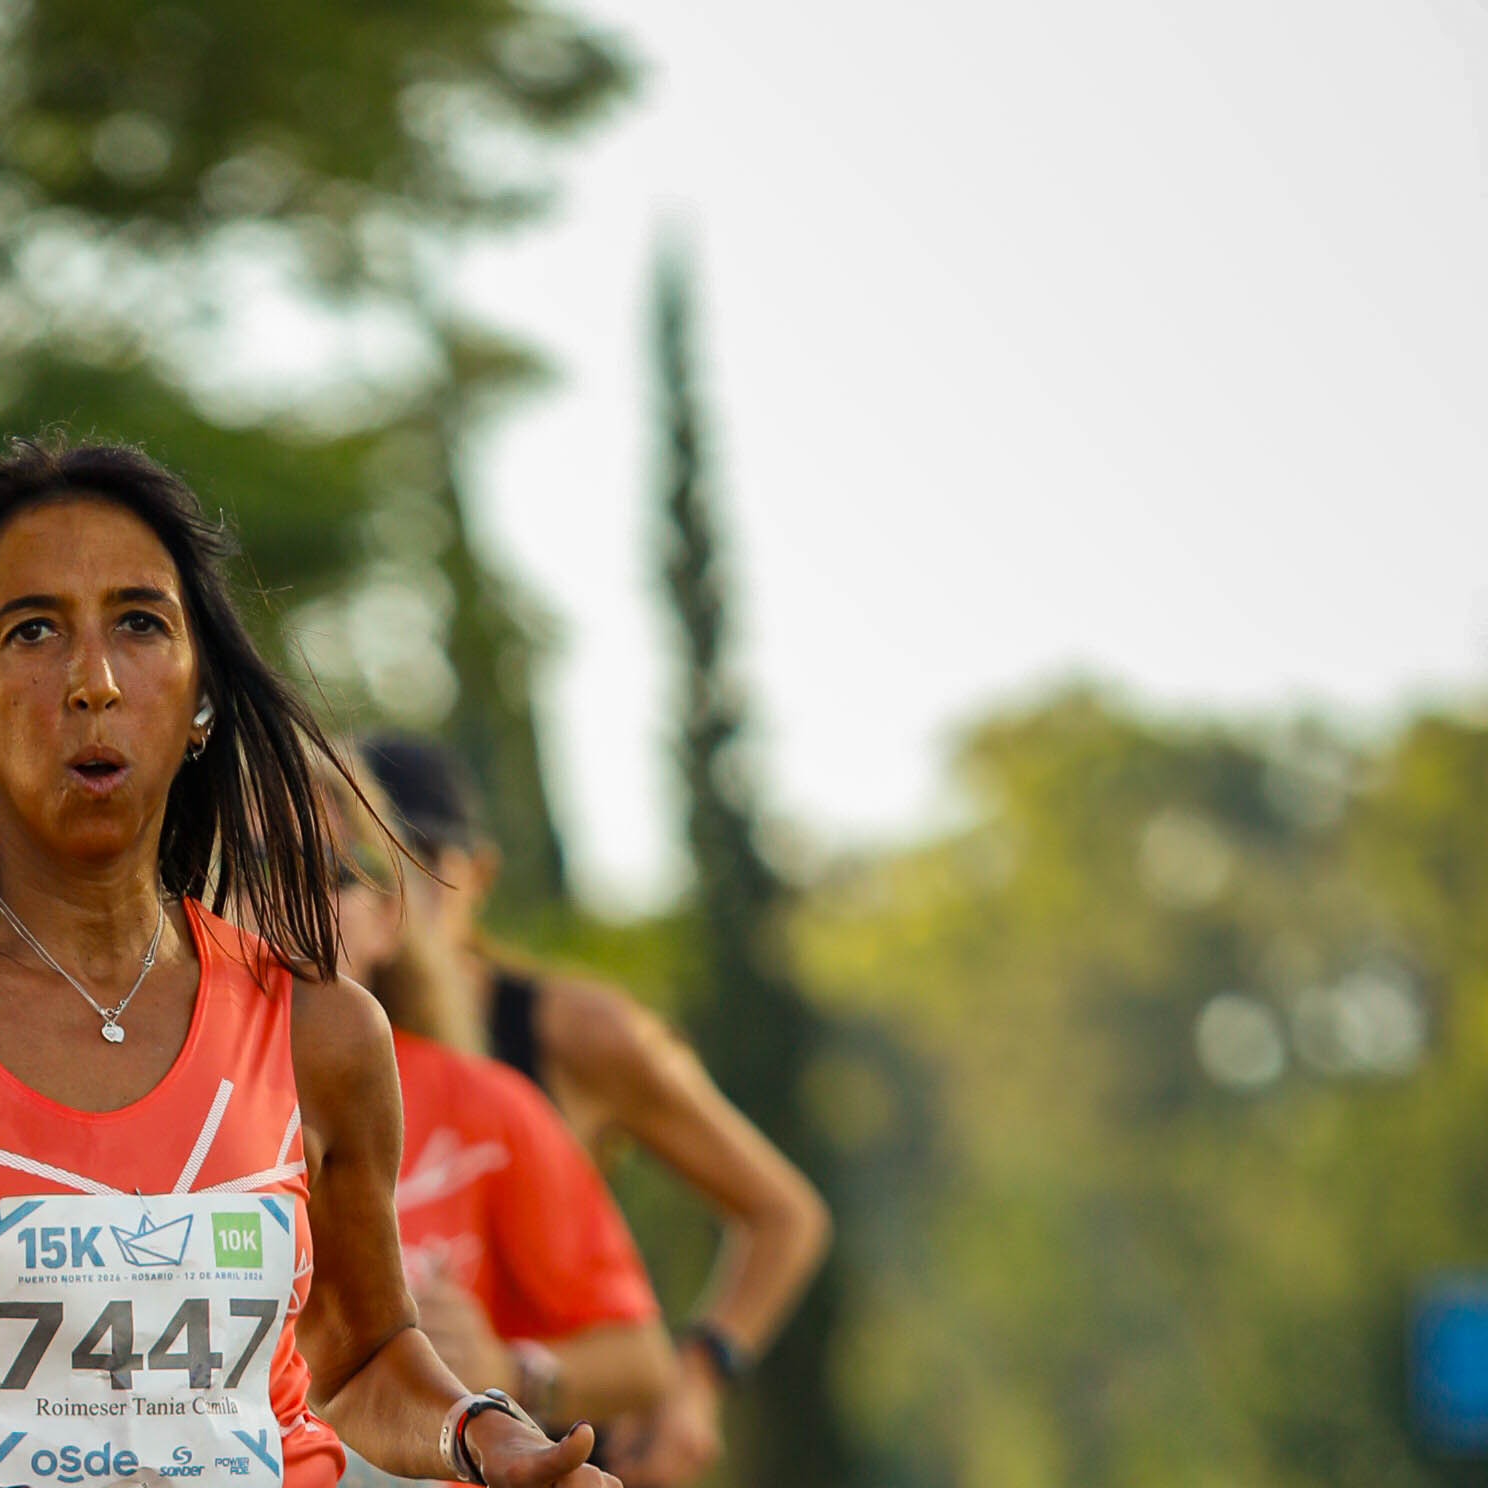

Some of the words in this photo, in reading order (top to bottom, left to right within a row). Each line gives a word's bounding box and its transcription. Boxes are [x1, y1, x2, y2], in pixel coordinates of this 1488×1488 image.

[18, 1226, 105, 1268] 15K
[218, 1229, 257, 1251] 10K
[18, 1274, 58, 1284] PUERTO
[61, 1274, 93, 1283] NORTE
[97, 1273, 121, 1282] 2026
[131, 1272, 174, 1281] ROSARIO
[184, 1272, 195, 1280] 12
[199, 1272, 211, 1280] DE
[215, 1272, 240, 1280] ABRIL
[36, 1398, 127, 1416] Roimeser
[132, 1397, 186, 1416] Tania
[31, 1441, 139, 1477] osde
